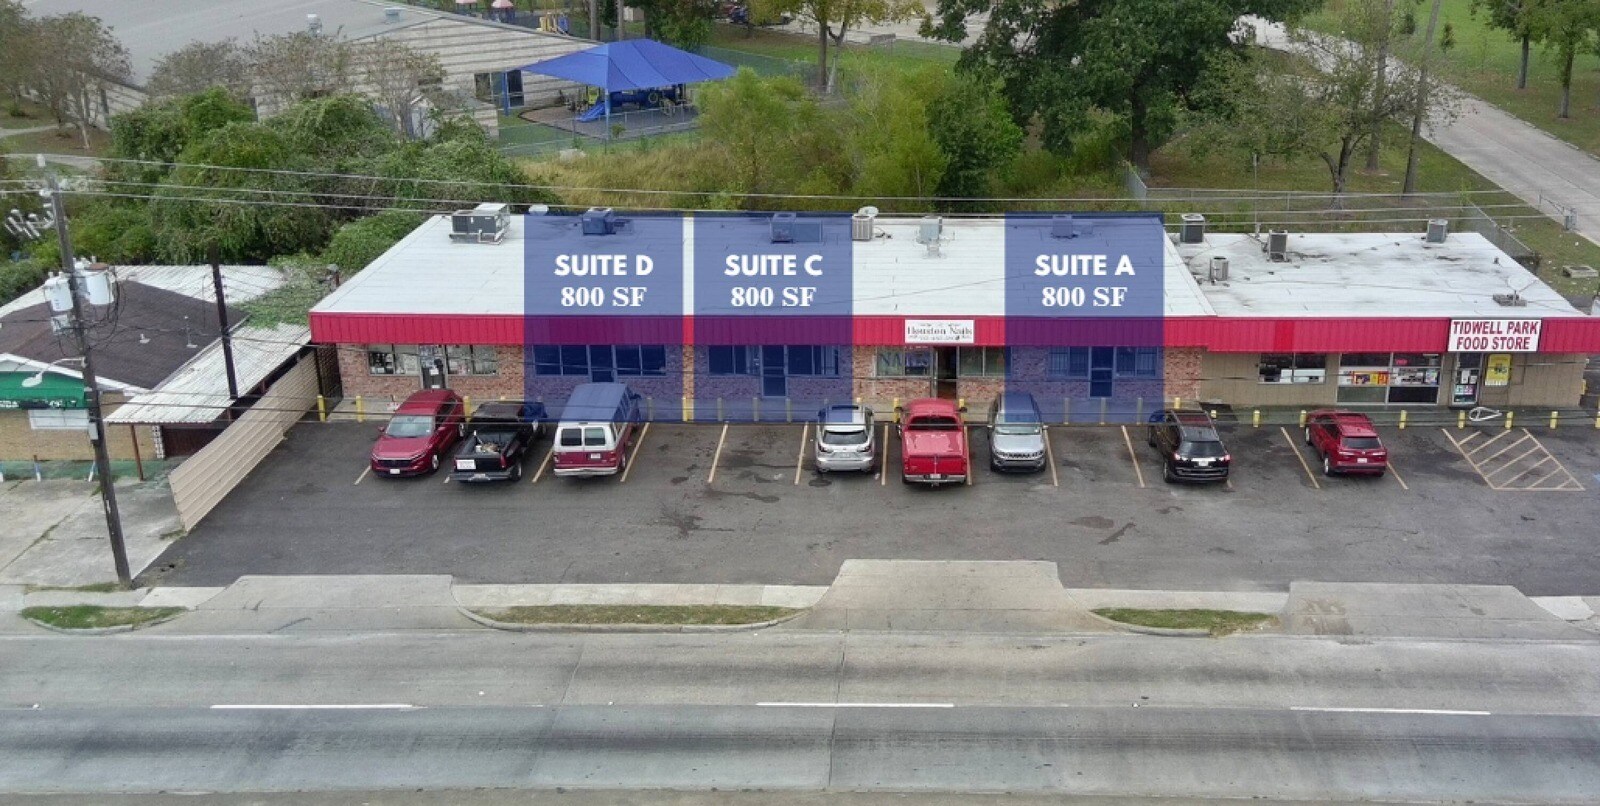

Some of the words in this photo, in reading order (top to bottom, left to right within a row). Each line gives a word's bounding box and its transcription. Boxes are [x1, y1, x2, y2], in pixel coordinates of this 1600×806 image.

[1453, 321, 1503, 335] TIDWELL
[1506, 321, 1539, 335] PARK
[1456, 336, 1489, 350] FOOD
[1492, 336, 1531, 350] STORE
